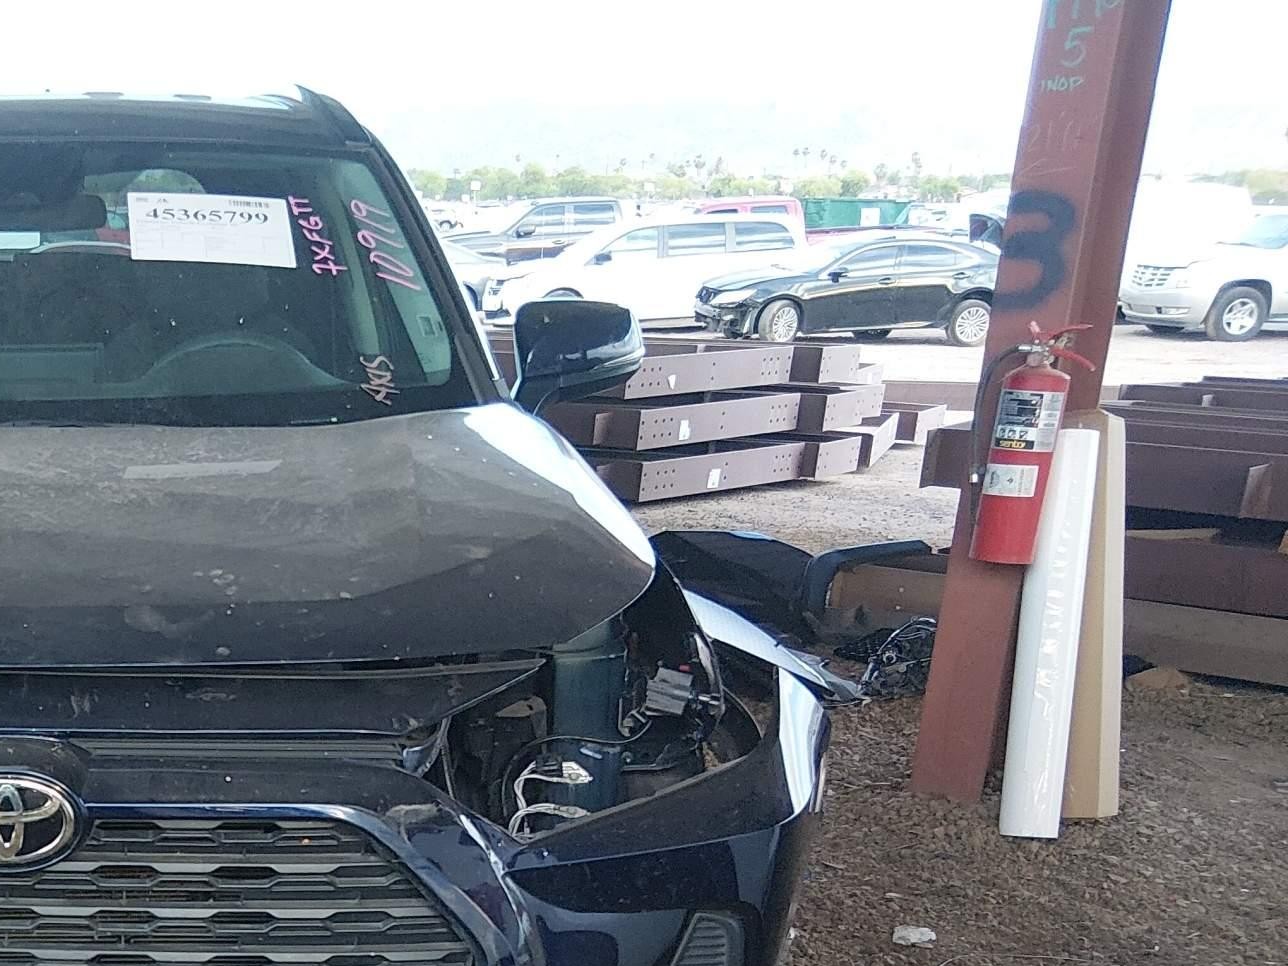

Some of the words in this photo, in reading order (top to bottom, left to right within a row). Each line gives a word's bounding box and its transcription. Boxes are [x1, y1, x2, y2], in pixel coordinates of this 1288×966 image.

[1061, 25, 1093, 68] 5
[145, 207, 270, 225] 45365799
[351, 199, 422, 291] 10919
[359, 355, 401, 406] AXIS
